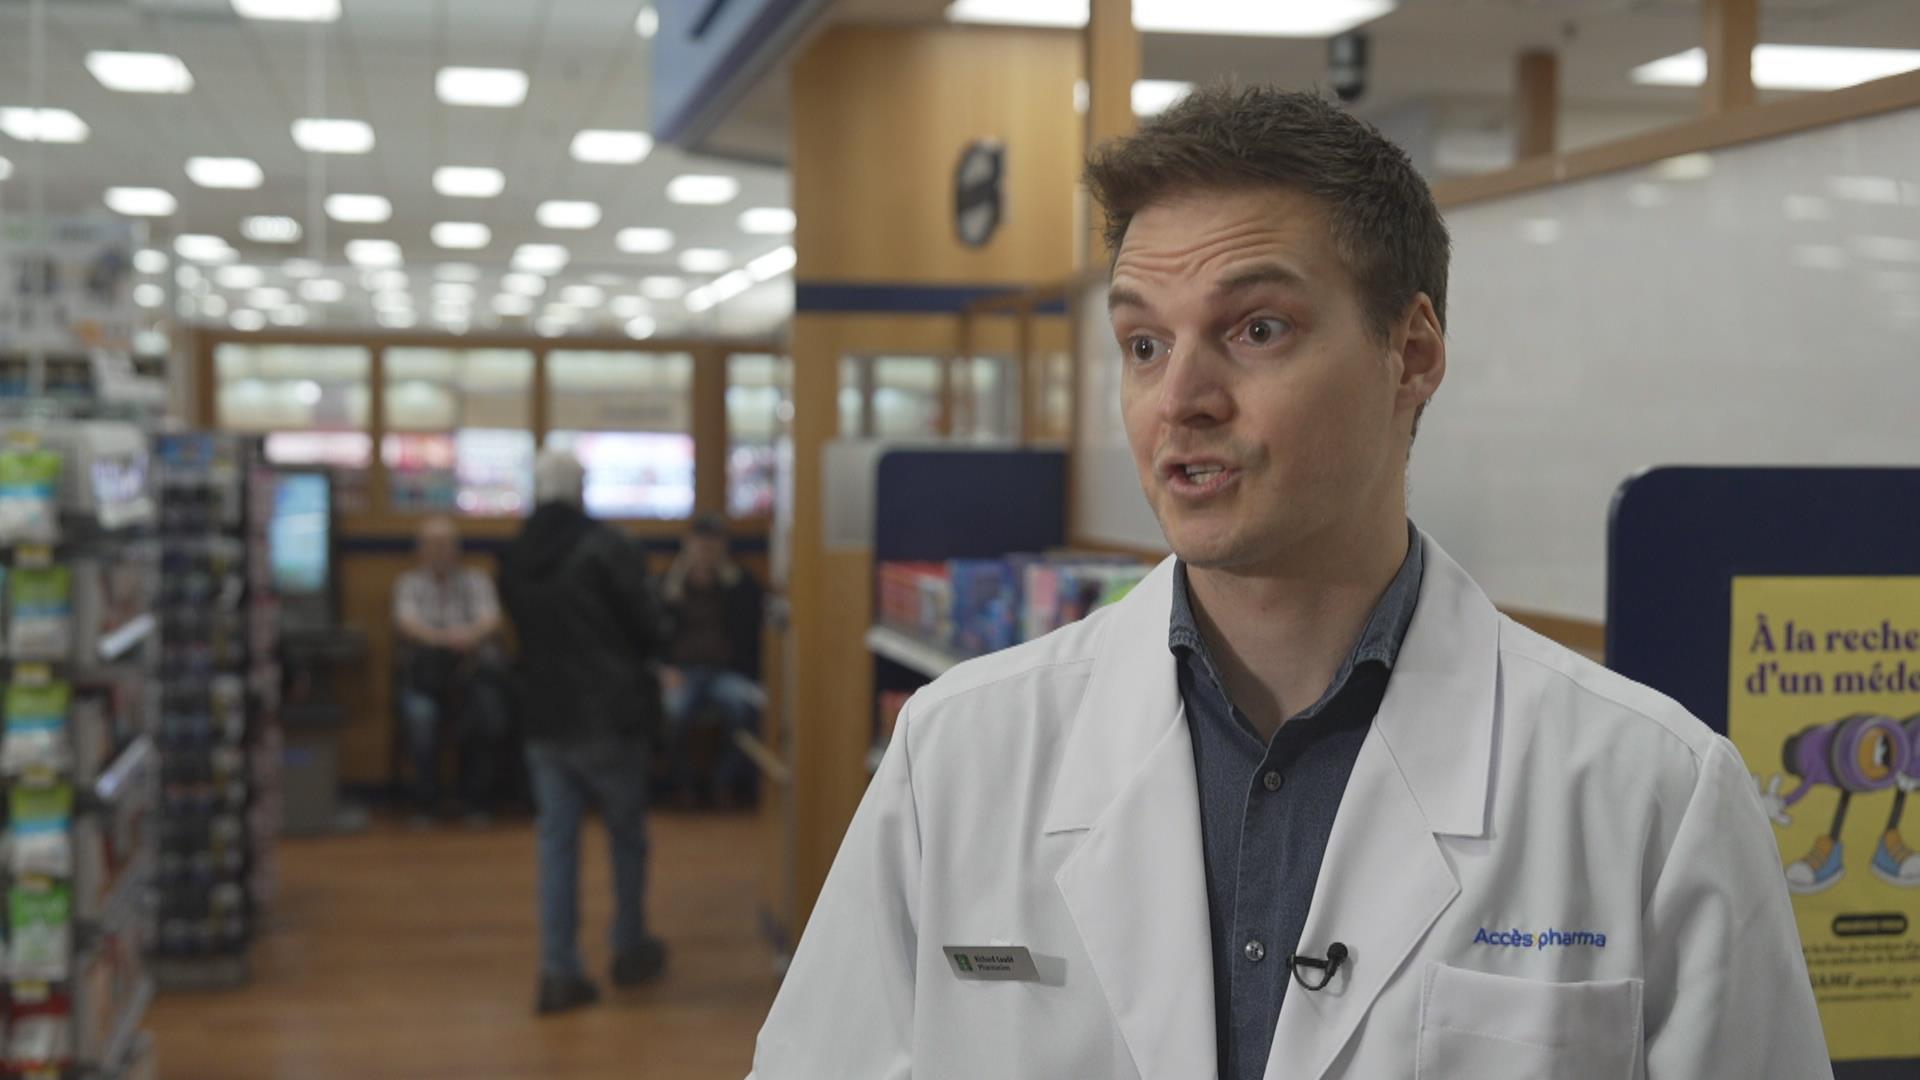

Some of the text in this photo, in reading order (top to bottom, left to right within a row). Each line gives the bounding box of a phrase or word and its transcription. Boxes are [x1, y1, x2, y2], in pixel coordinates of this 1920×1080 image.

[1750, 613, 1920, 652] À la reche
[1746, 661, 1823, 693] d'un
[1473, 927, 1607, 951] Accès pharma
